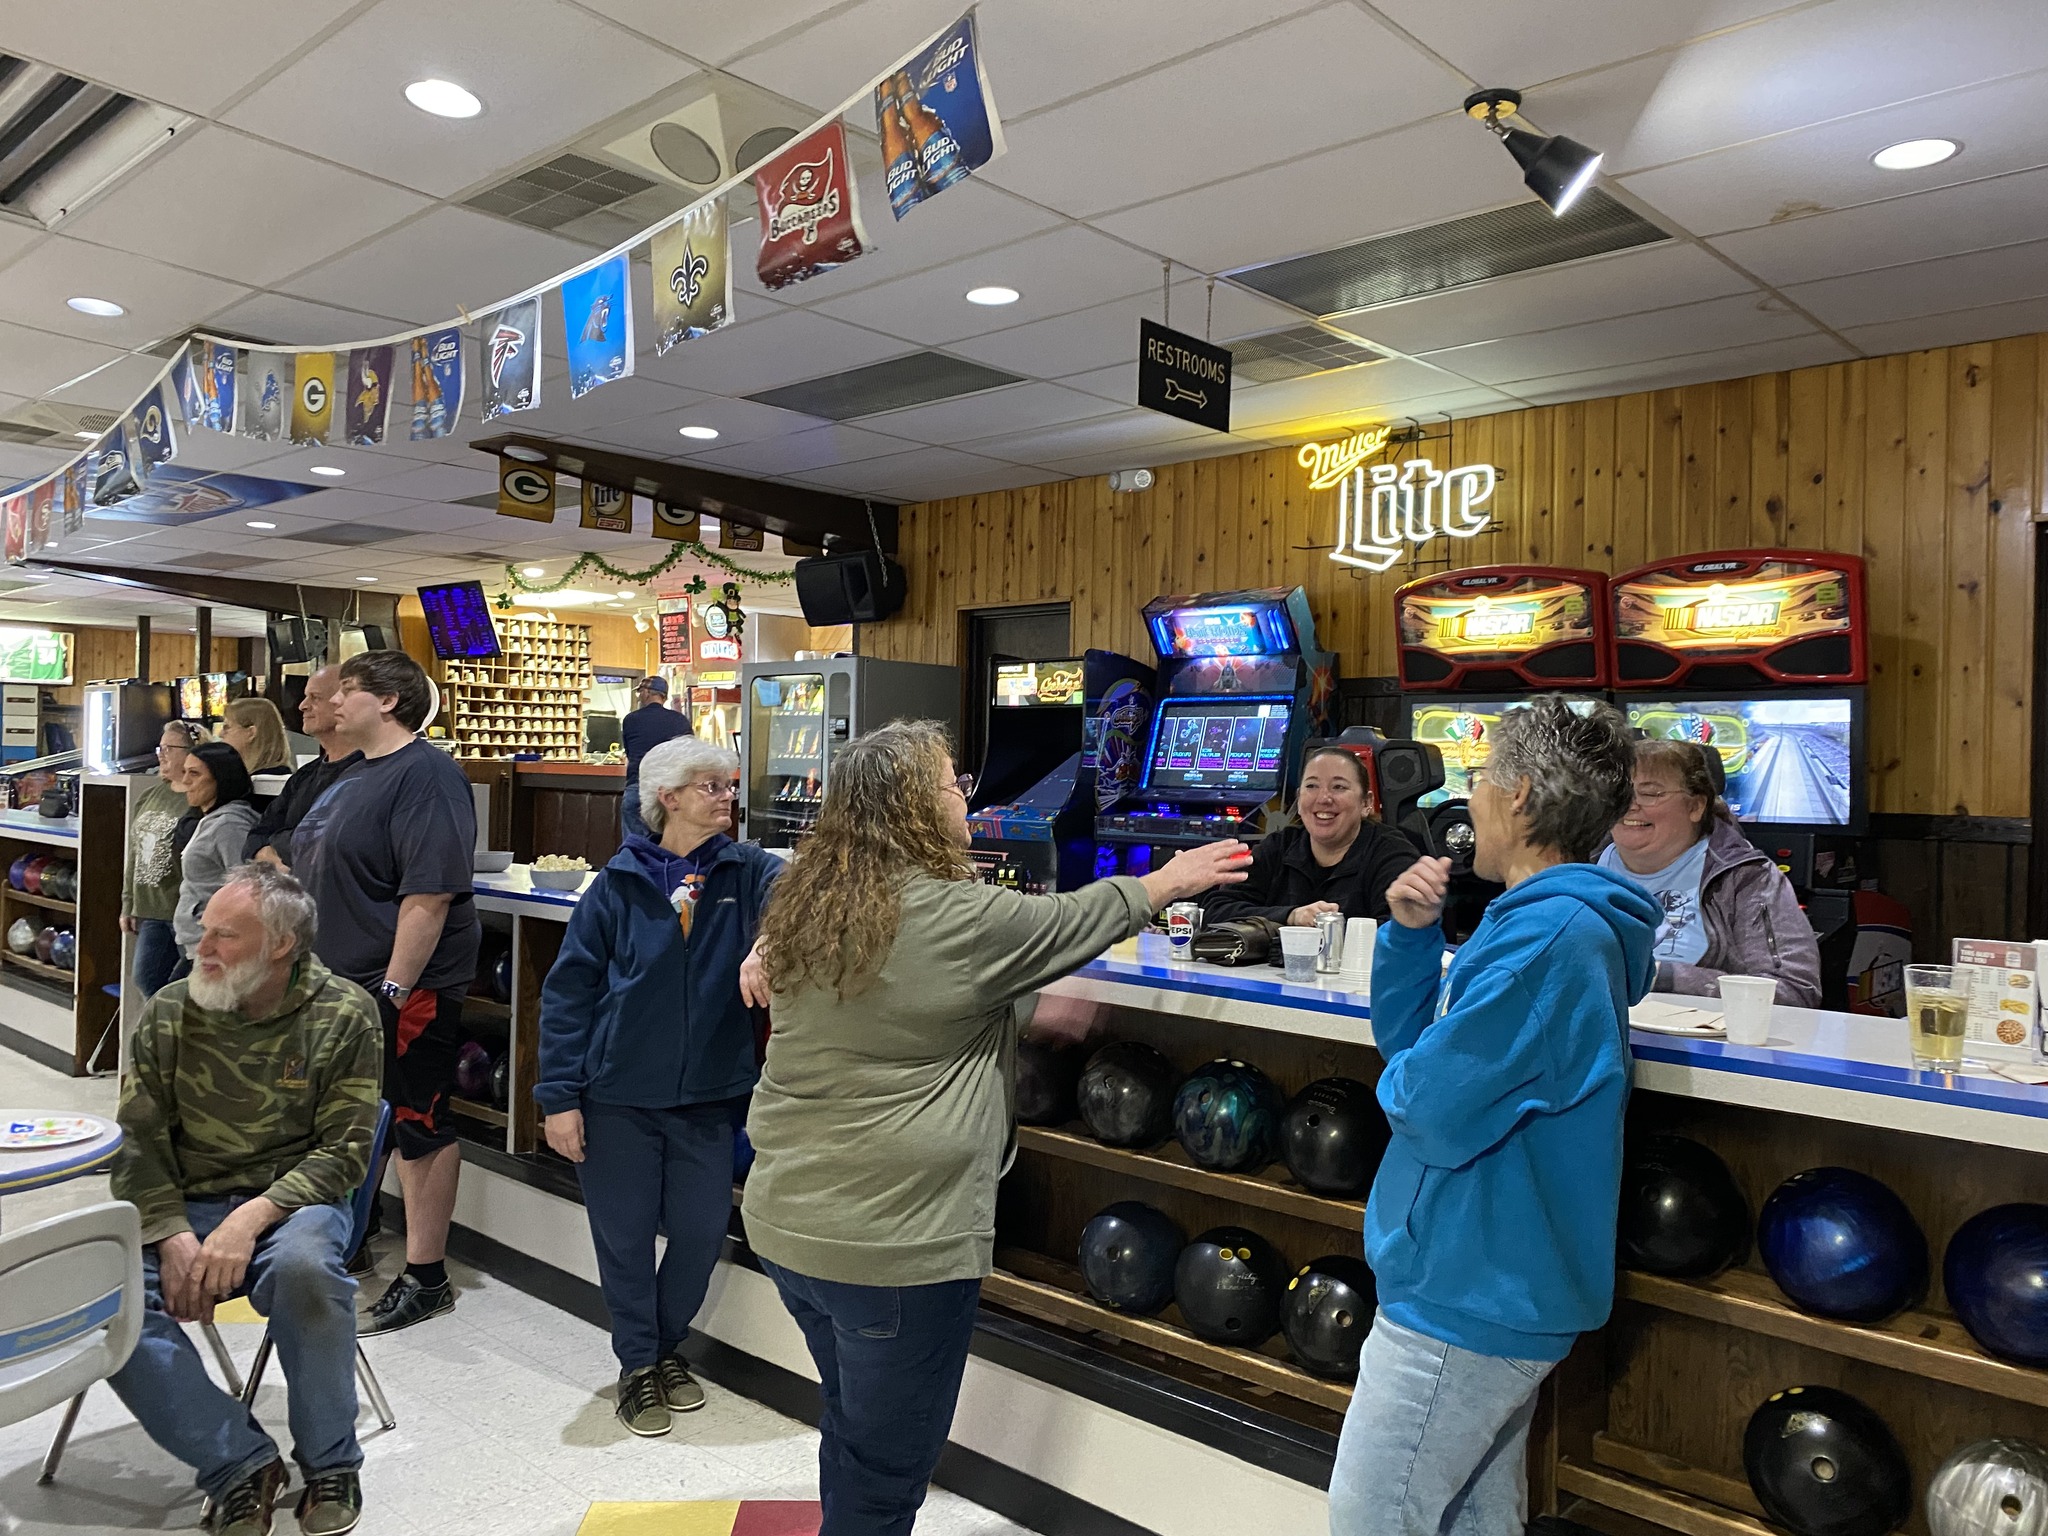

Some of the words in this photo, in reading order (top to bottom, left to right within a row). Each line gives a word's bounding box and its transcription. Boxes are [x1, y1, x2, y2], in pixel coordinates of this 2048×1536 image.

[931, 37, 963, 67] BUD
[923, 136, 950, 162] BUD
[887, 160, 913, 184] BUD
[889, 169, 917, 195] IGHT
[770, 191, 837, 239] BUCCANEERS
[437, 342, 456, 352] BUD
[1148, 338, 1225, 384] RESTROOMS
[303, 378, 326, 413] G
[1298, 426, 1391, 481] Miller
[504, 470, 549, 503] G
[599, 519, 623, 529] ESPN
[1329, 458, 1495, 571] Lite
[1694, 563, 1722, 572] GLOBAL
[1723, 562, 1737, 570] VR
[1462, 578, 1487, 586] GLOBAL
[1466, 613, 1531, 637] NASCAR
[1698, 603, 1776, 628] NASCAR
[1170, 926, 1192, 935] EPSI
